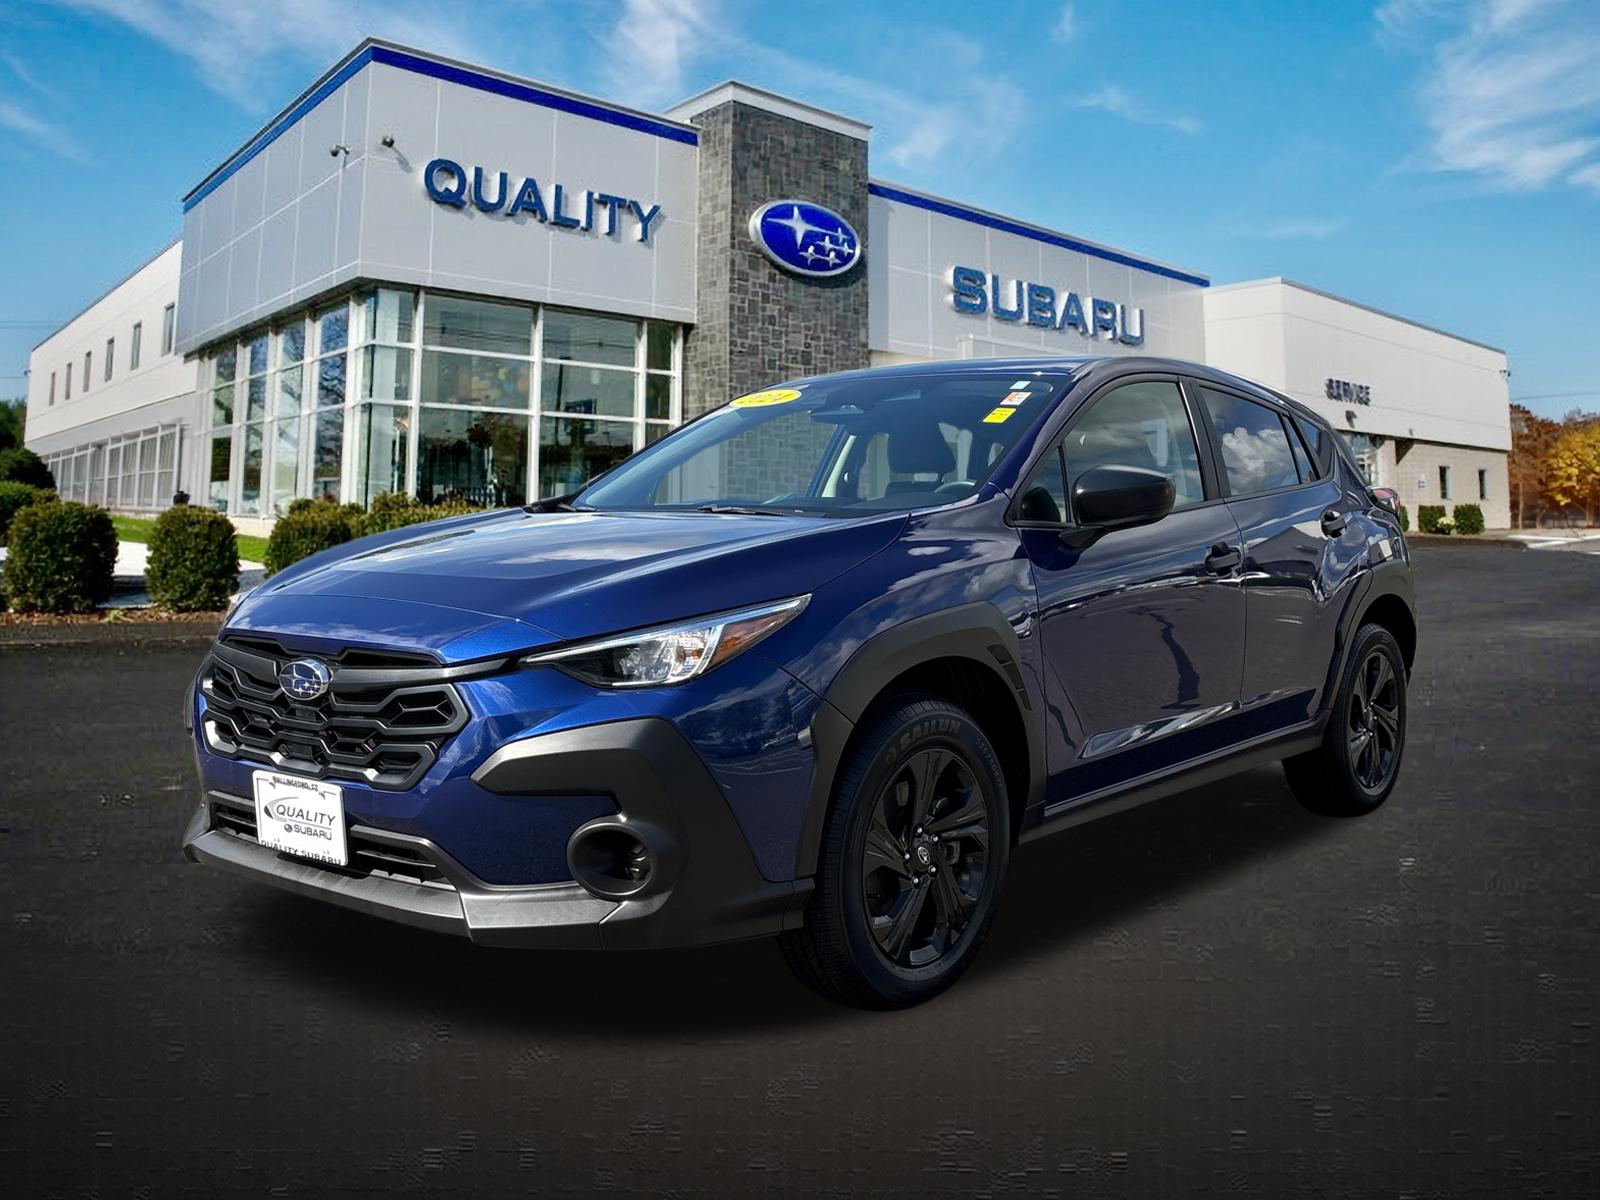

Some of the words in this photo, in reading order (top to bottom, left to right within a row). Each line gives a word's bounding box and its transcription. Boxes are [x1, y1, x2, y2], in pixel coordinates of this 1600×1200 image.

[423, 158, 662, 242] QUALITY
[949, 265, 1145, 346] SUBARU
[898, 718, 961, 751] SAILUN
[276, 805, 335, 826] QUALITY
[293, 825, 332, 840] SUBARU
